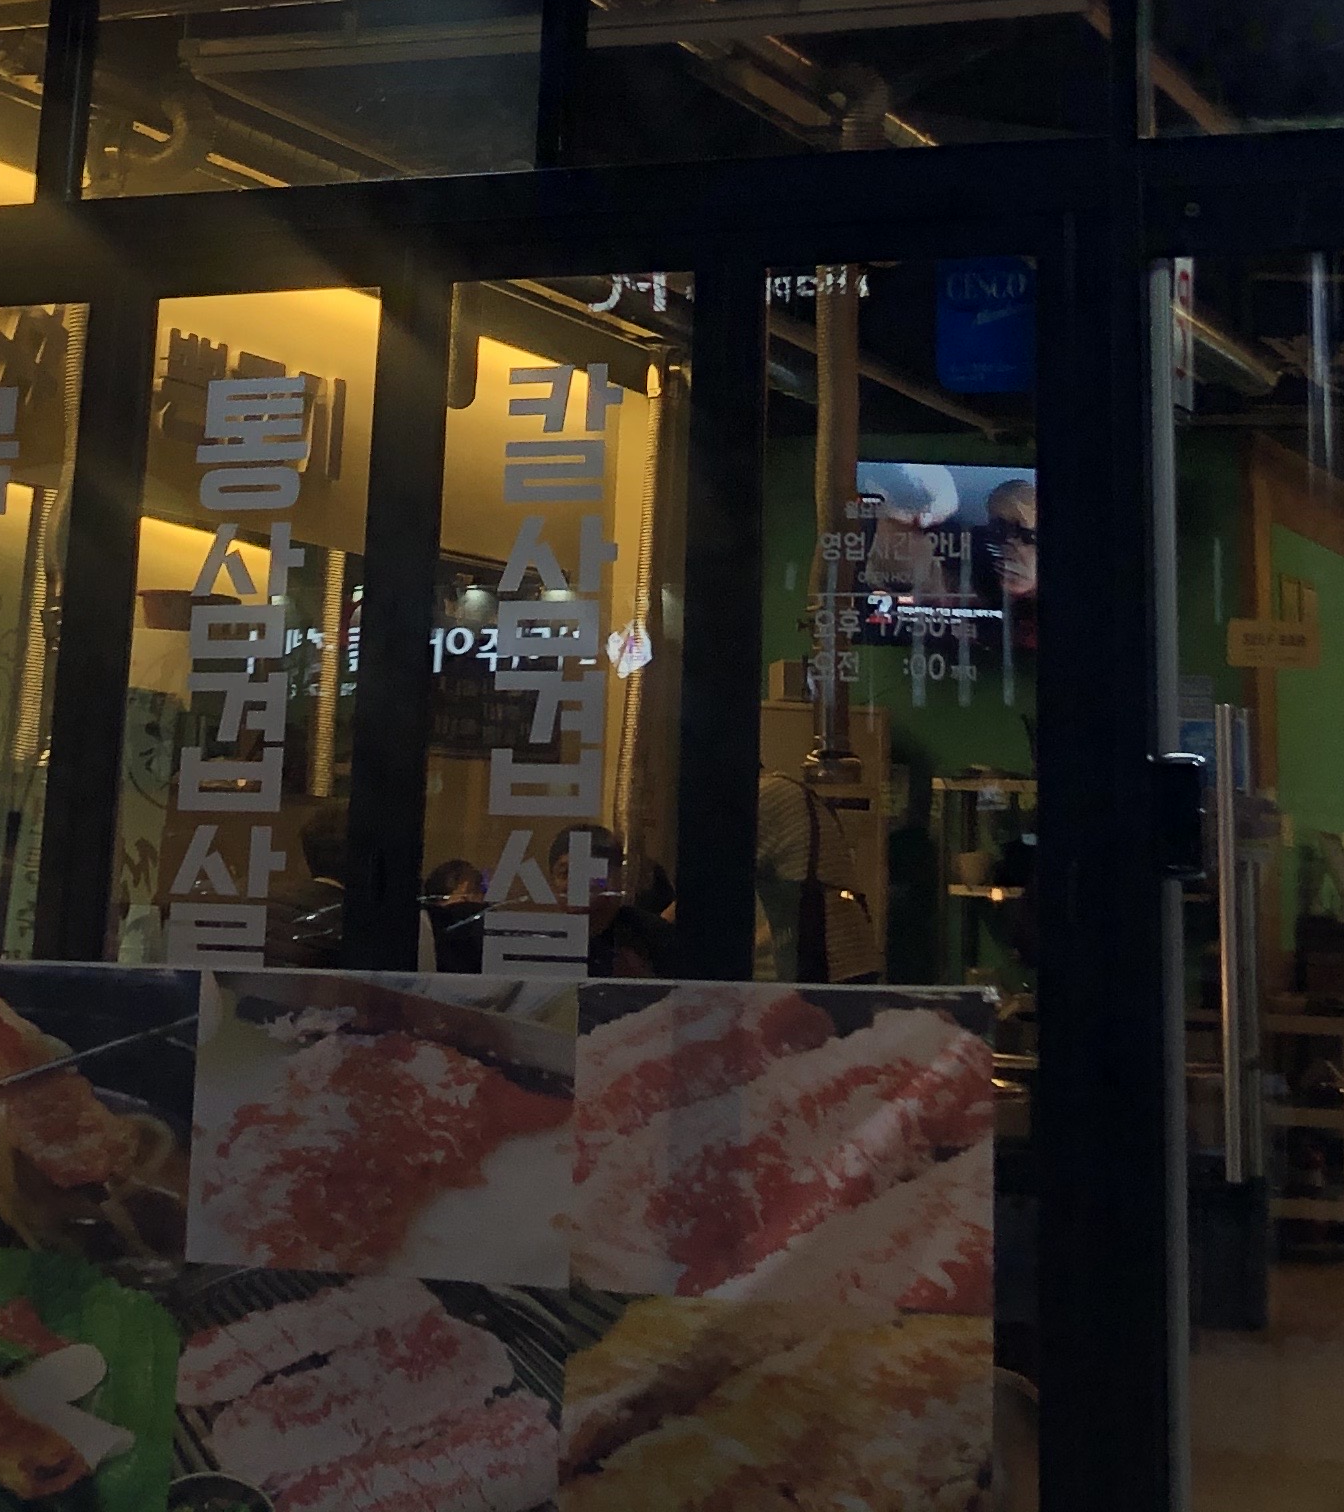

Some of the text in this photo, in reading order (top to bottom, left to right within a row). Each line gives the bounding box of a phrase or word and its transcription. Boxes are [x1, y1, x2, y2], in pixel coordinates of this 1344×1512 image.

[167, 376, 306, 968] 통삼겹살
[481, 362, 623, 976] 칼삼겹살
[808, 650, 860, 683] 오전
[813, 608, 862, 639] 오후
